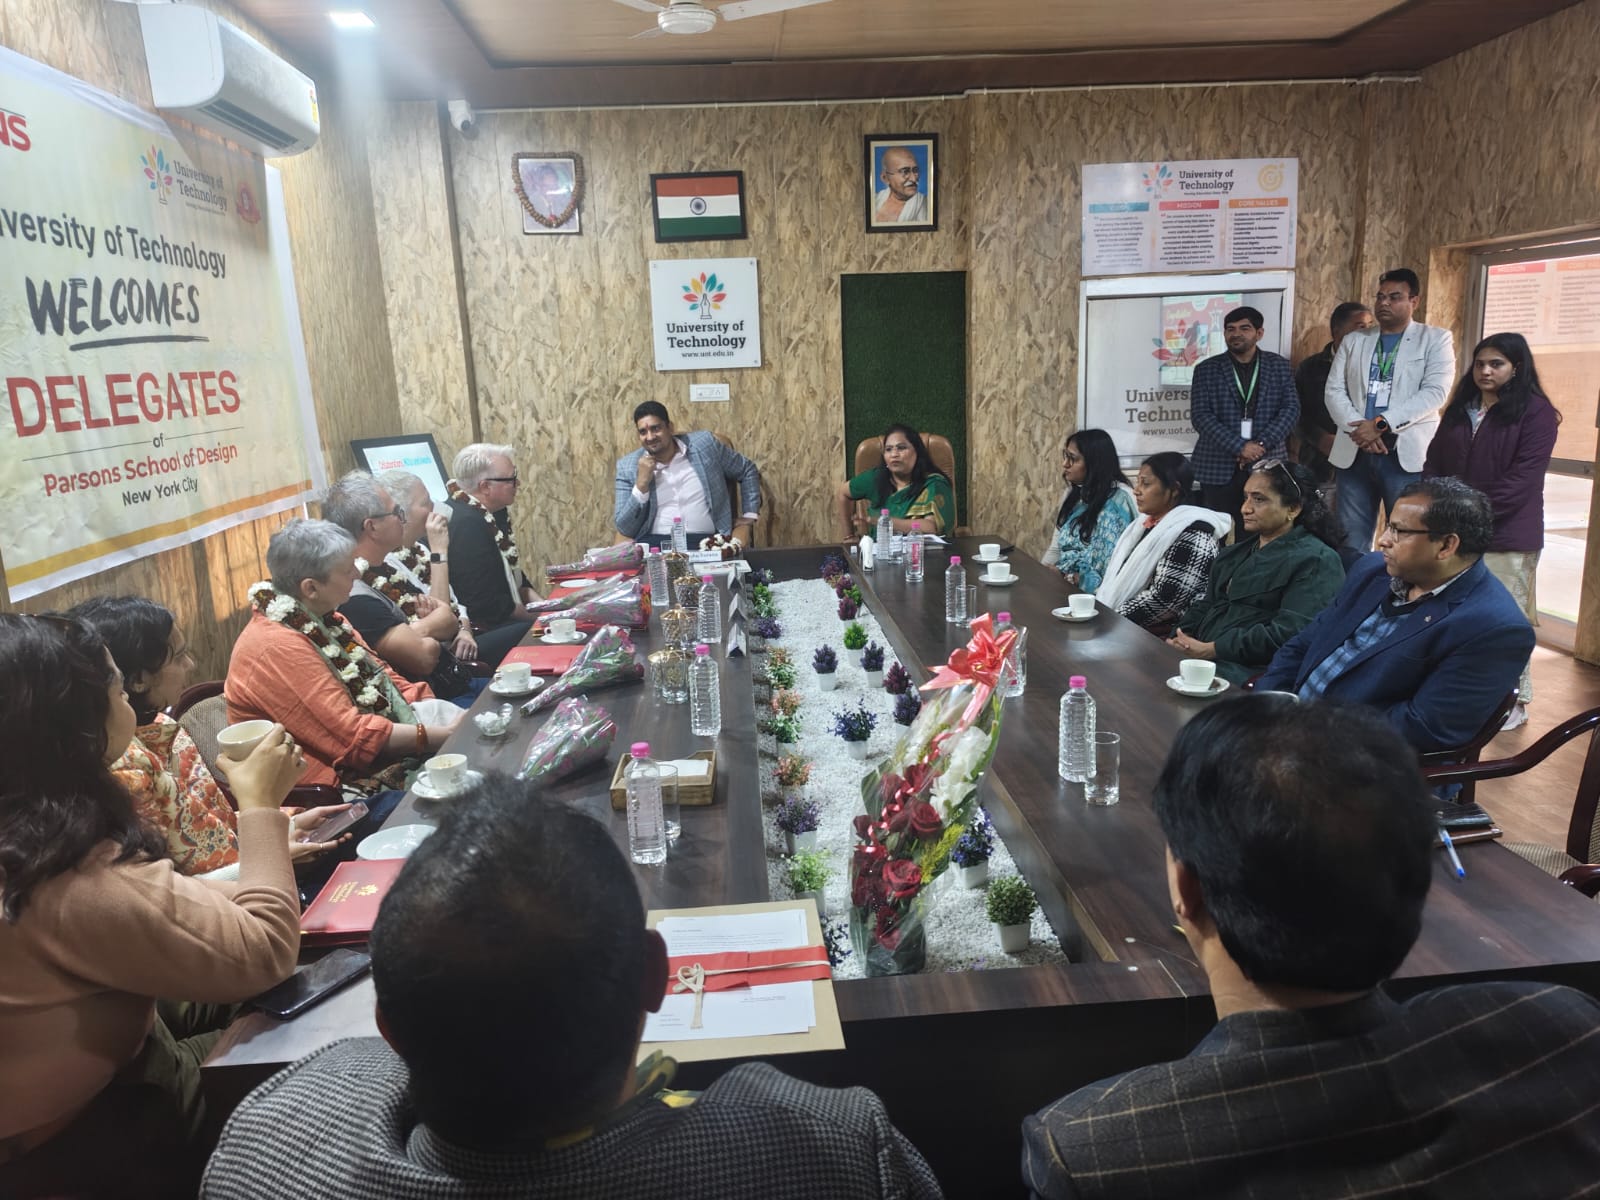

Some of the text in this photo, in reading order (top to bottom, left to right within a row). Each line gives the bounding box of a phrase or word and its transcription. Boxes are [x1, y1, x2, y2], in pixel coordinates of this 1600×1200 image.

[174, 160, 214, 190] University
[1179, 168, 1234, 180] University of
[177, 179, 227, 212] Technology
[1179, 180, 1234, 191] Technology
[104, 225, 124, 256] of
[127, 227, 226, 279] Technology
[25, 275, 200, 337] WELCOMES
[666, 320, 744, 334] University of
[667, 335, 746, 349] Technology
[681, 350, 734, 358] www.uot.edu.in
[6, 370, 241, 438] DELEGATES
[1125, 388, 1192, 403] Univers
[152, 433, 164, 448] of
[44, 442, 238, 496] Parsons School of Design
[122, 477, 199, 507] New York City
